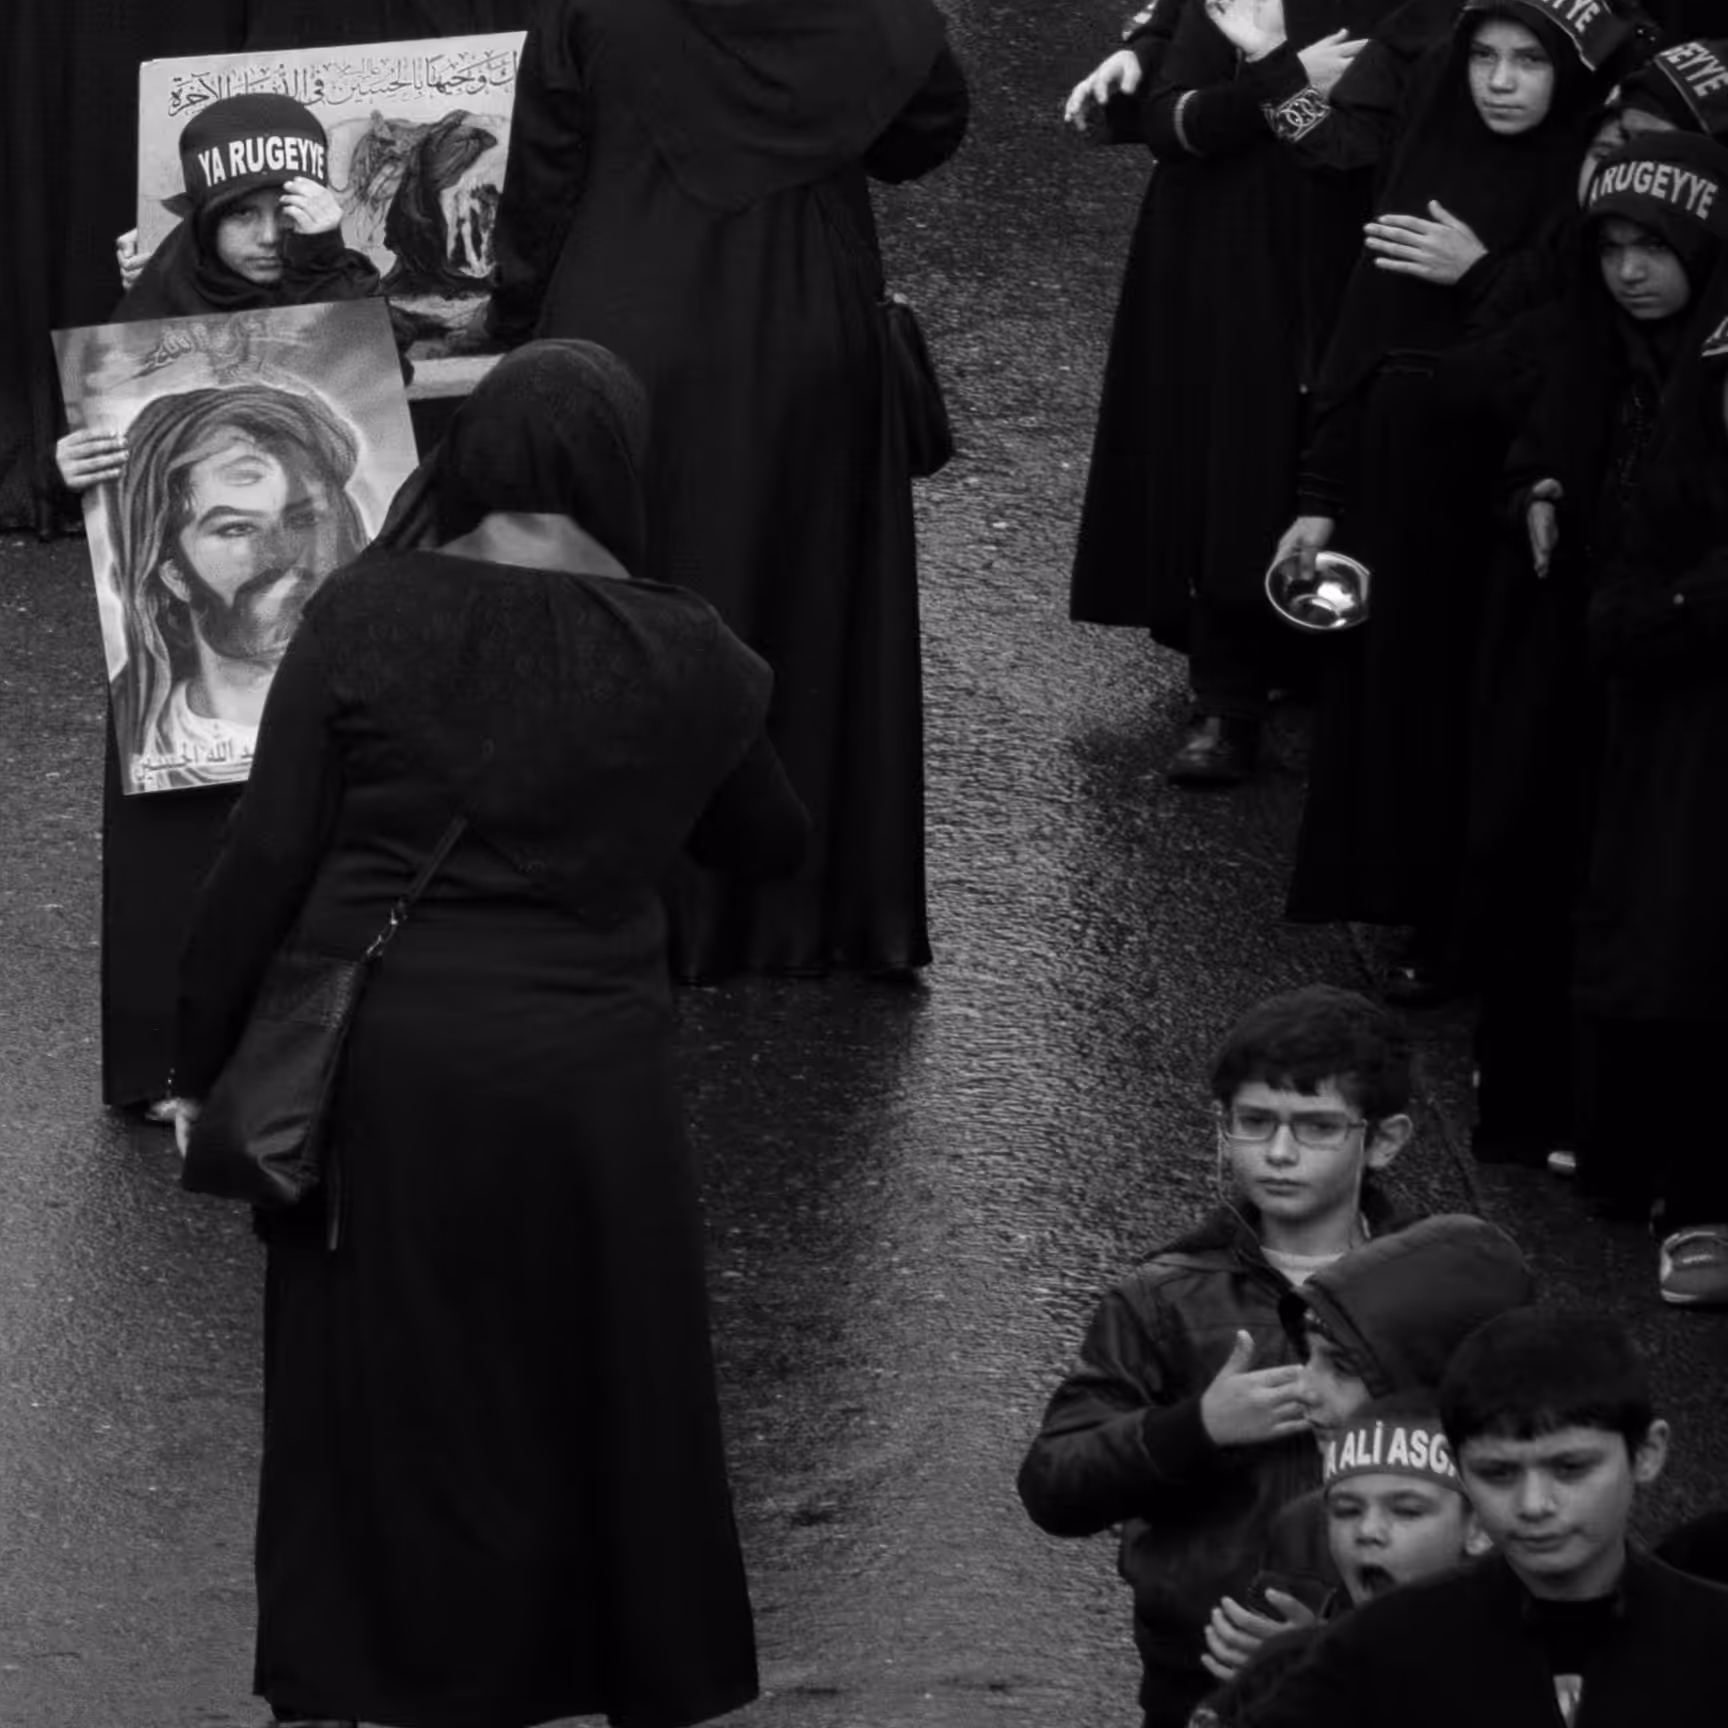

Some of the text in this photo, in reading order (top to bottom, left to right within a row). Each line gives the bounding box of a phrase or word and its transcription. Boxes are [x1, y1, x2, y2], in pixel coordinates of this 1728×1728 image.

[199, 136, 326, 187] YA RUGEYYE
[1599, 160, 1720, 222] RUGEYYE
[1339, 1420, 1455, 1474] ALİ ASG
